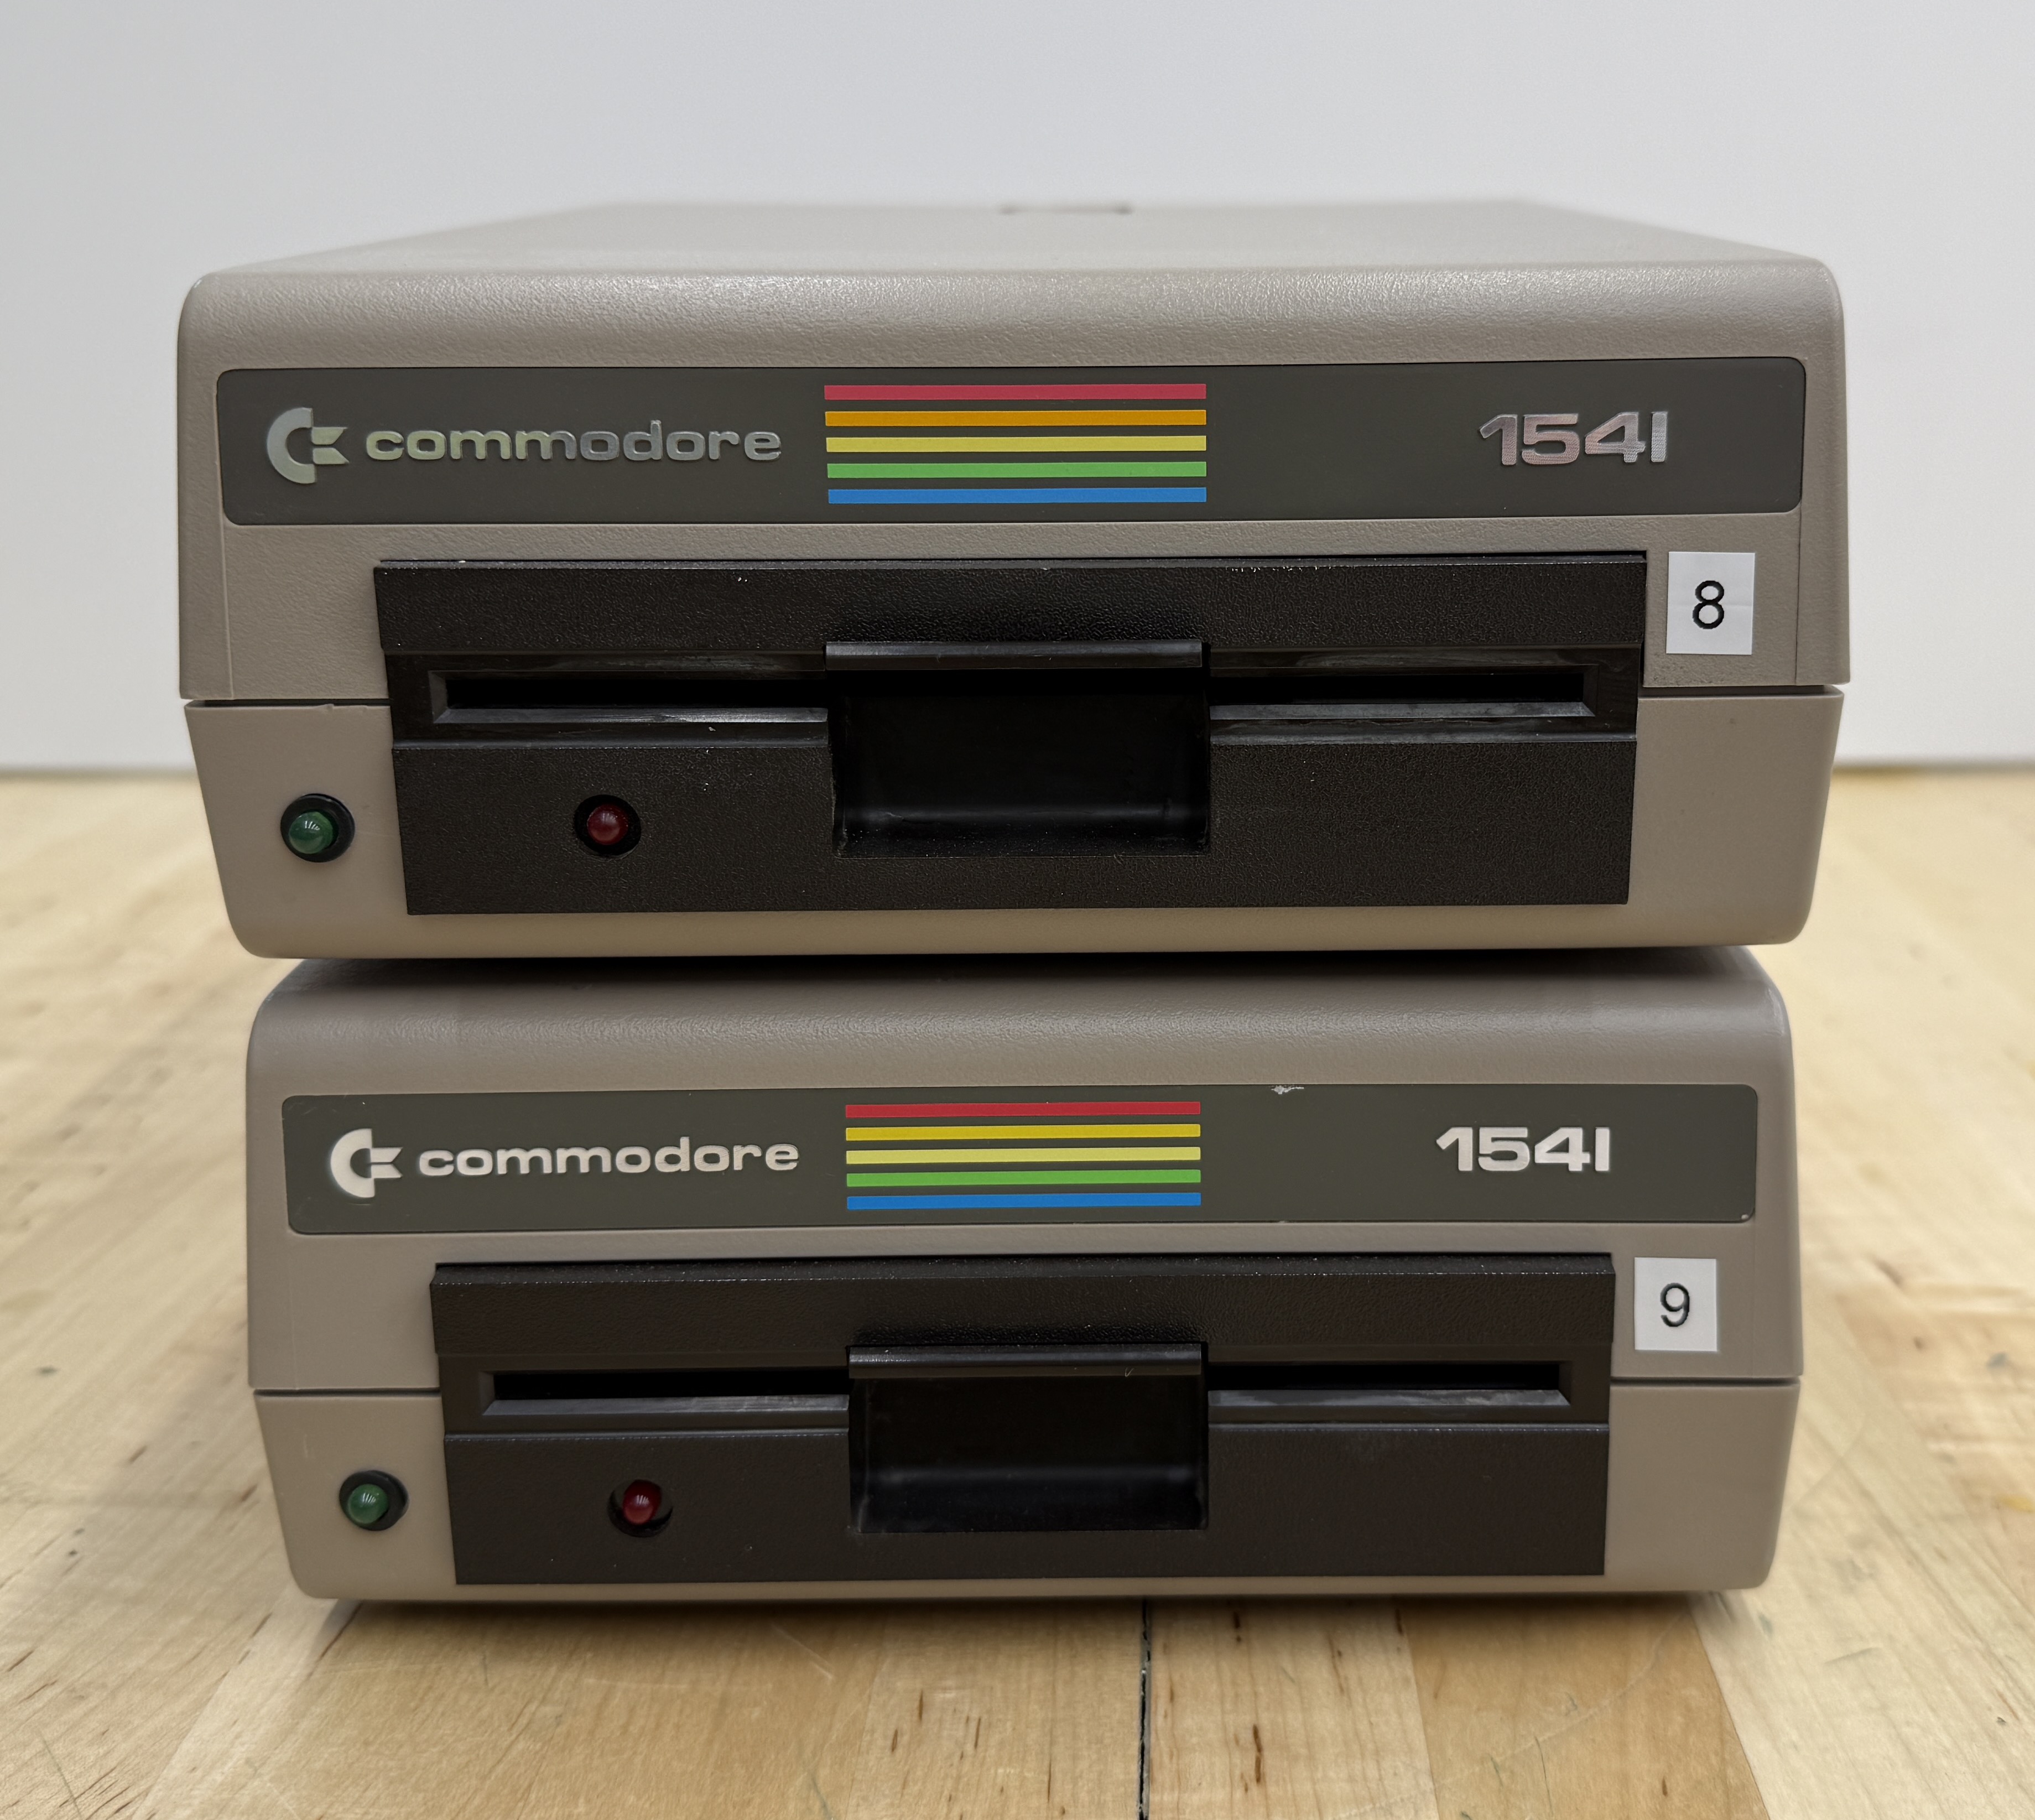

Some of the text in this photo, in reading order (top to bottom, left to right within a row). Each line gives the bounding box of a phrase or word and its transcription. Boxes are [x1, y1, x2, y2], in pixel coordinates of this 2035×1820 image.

[365, 419, 782, 461] commodore
[1479, 411, 1668, 466] 1541
[1692, 580, 1725, 630] 8
[418, 1136, 799, 1177] commodore
[1436, 1126, 1610, 1172] 1541
[1660, 1282, 1690, 1328] 9
